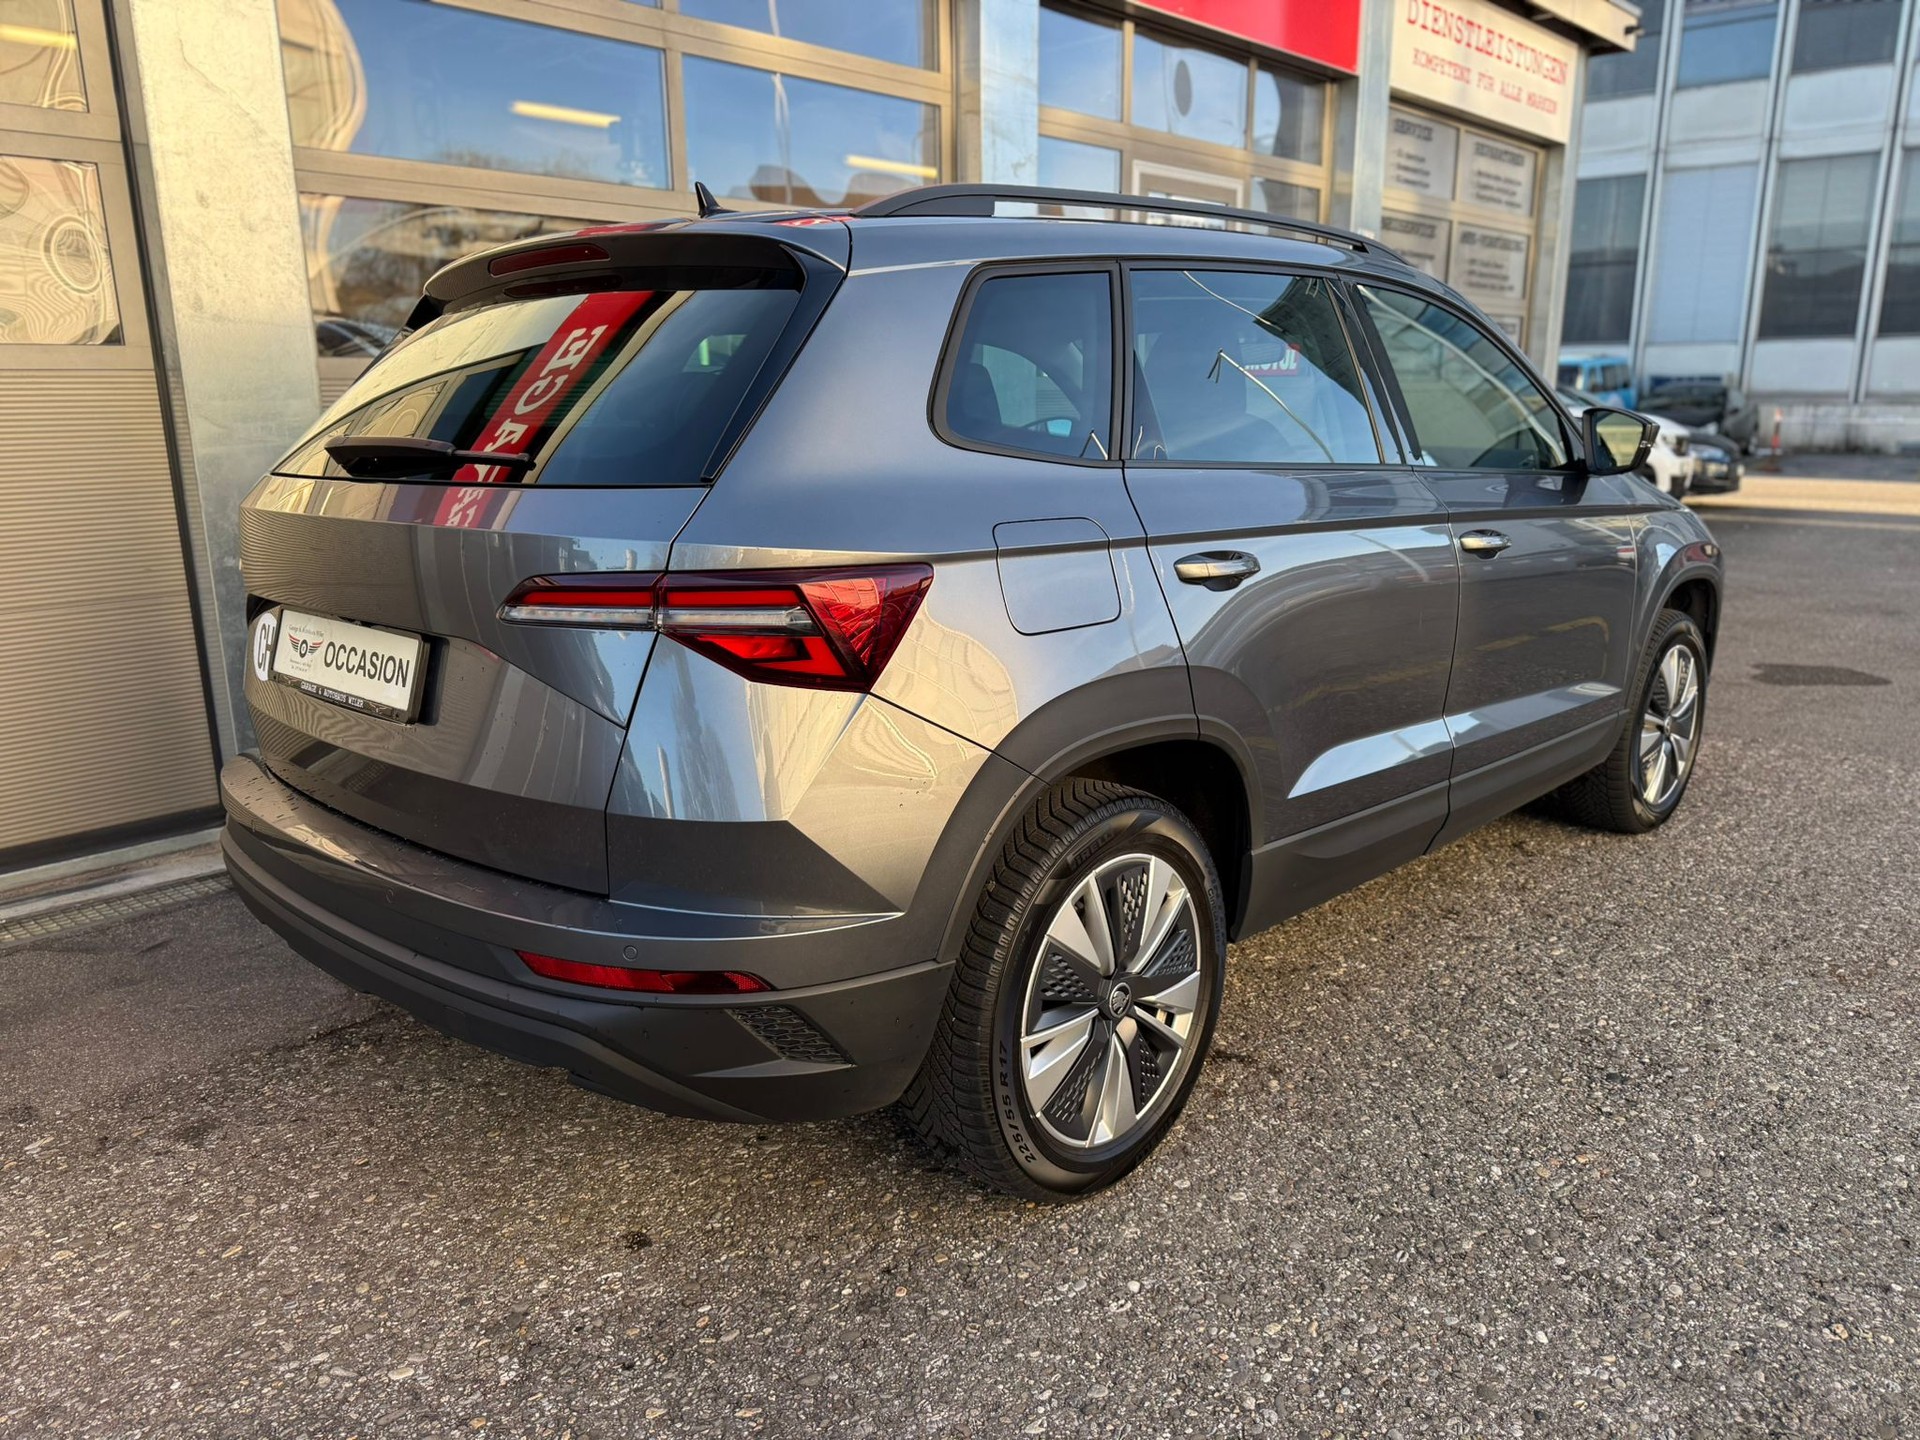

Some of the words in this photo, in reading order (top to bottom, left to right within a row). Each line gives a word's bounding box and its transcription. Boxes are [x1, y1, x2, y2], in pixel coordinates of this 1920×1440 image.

[1407, 0, 1568, 85] DIENSTLEISTUNGEN
[1500, 80, 1523, 102] ALLE
[257, 623, 275, 672] CH
[324, 641, 409, 688] OCCASION
[1002, 1094, 1037, 1163] 225/55
